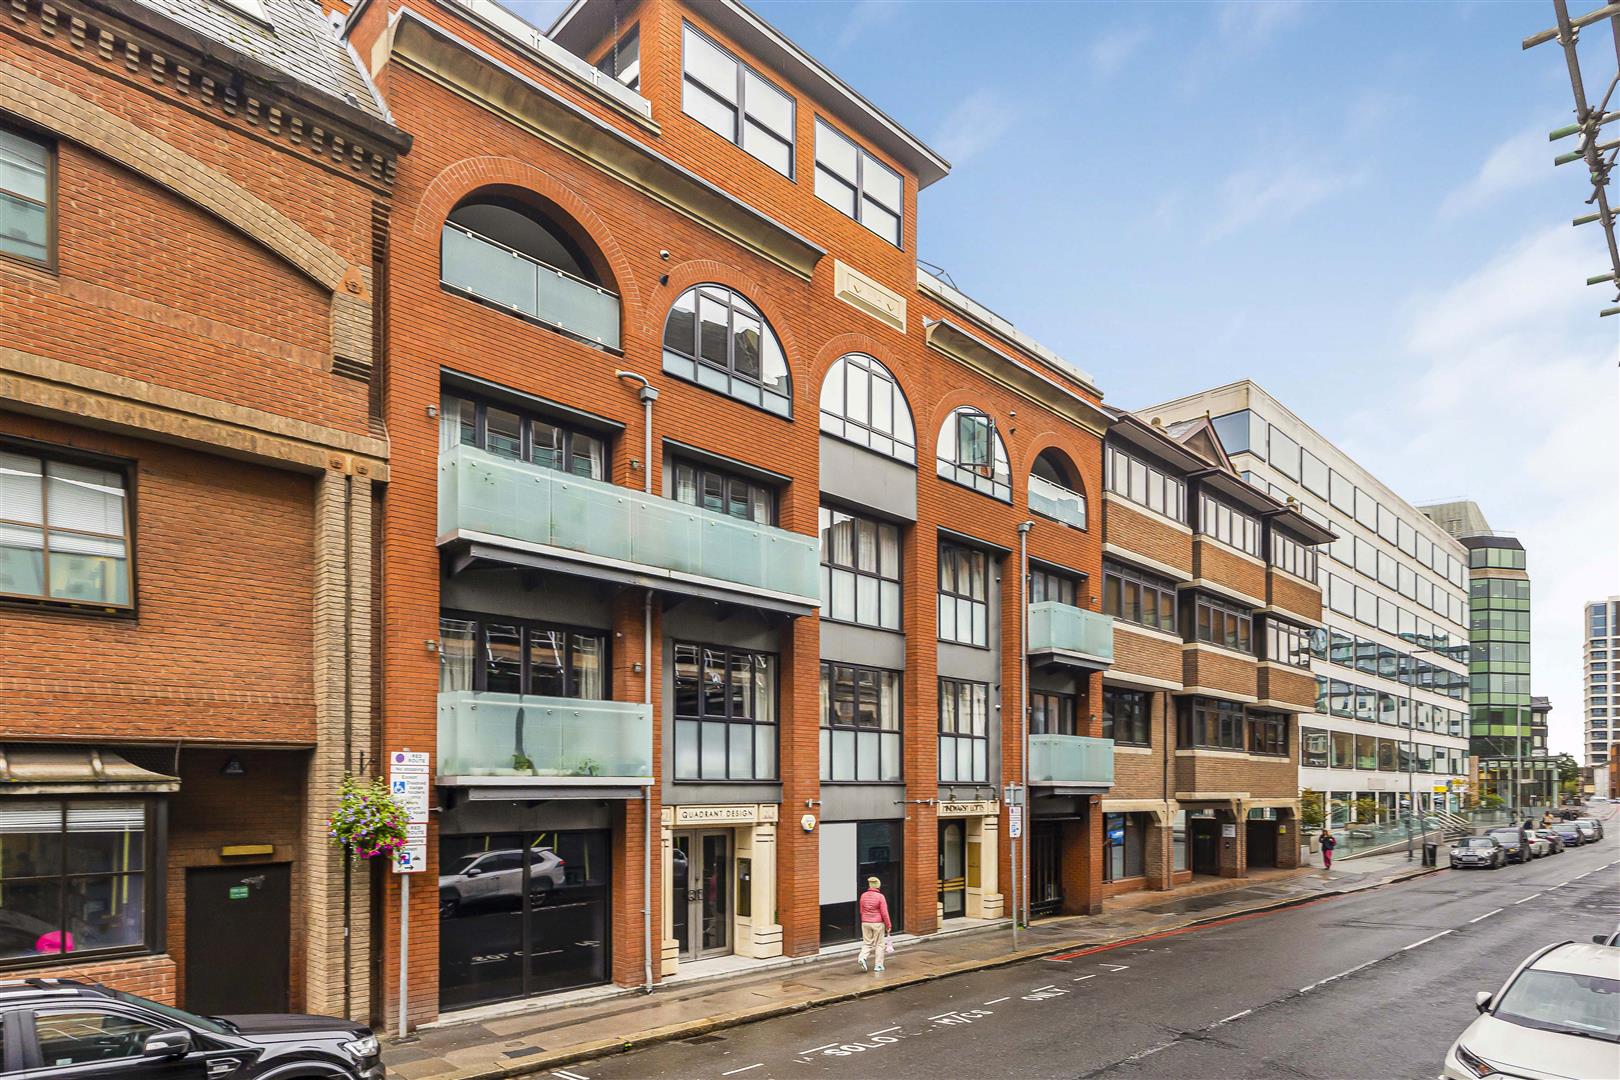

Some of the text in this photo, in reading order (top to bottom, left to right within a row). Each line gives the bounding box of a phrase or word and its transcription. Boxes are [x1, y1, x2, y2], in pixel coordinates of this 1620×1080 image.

[682, 809, 753, 819] QUADRANT DESIGN
[823, 1036, 899, 1056] SOLO
